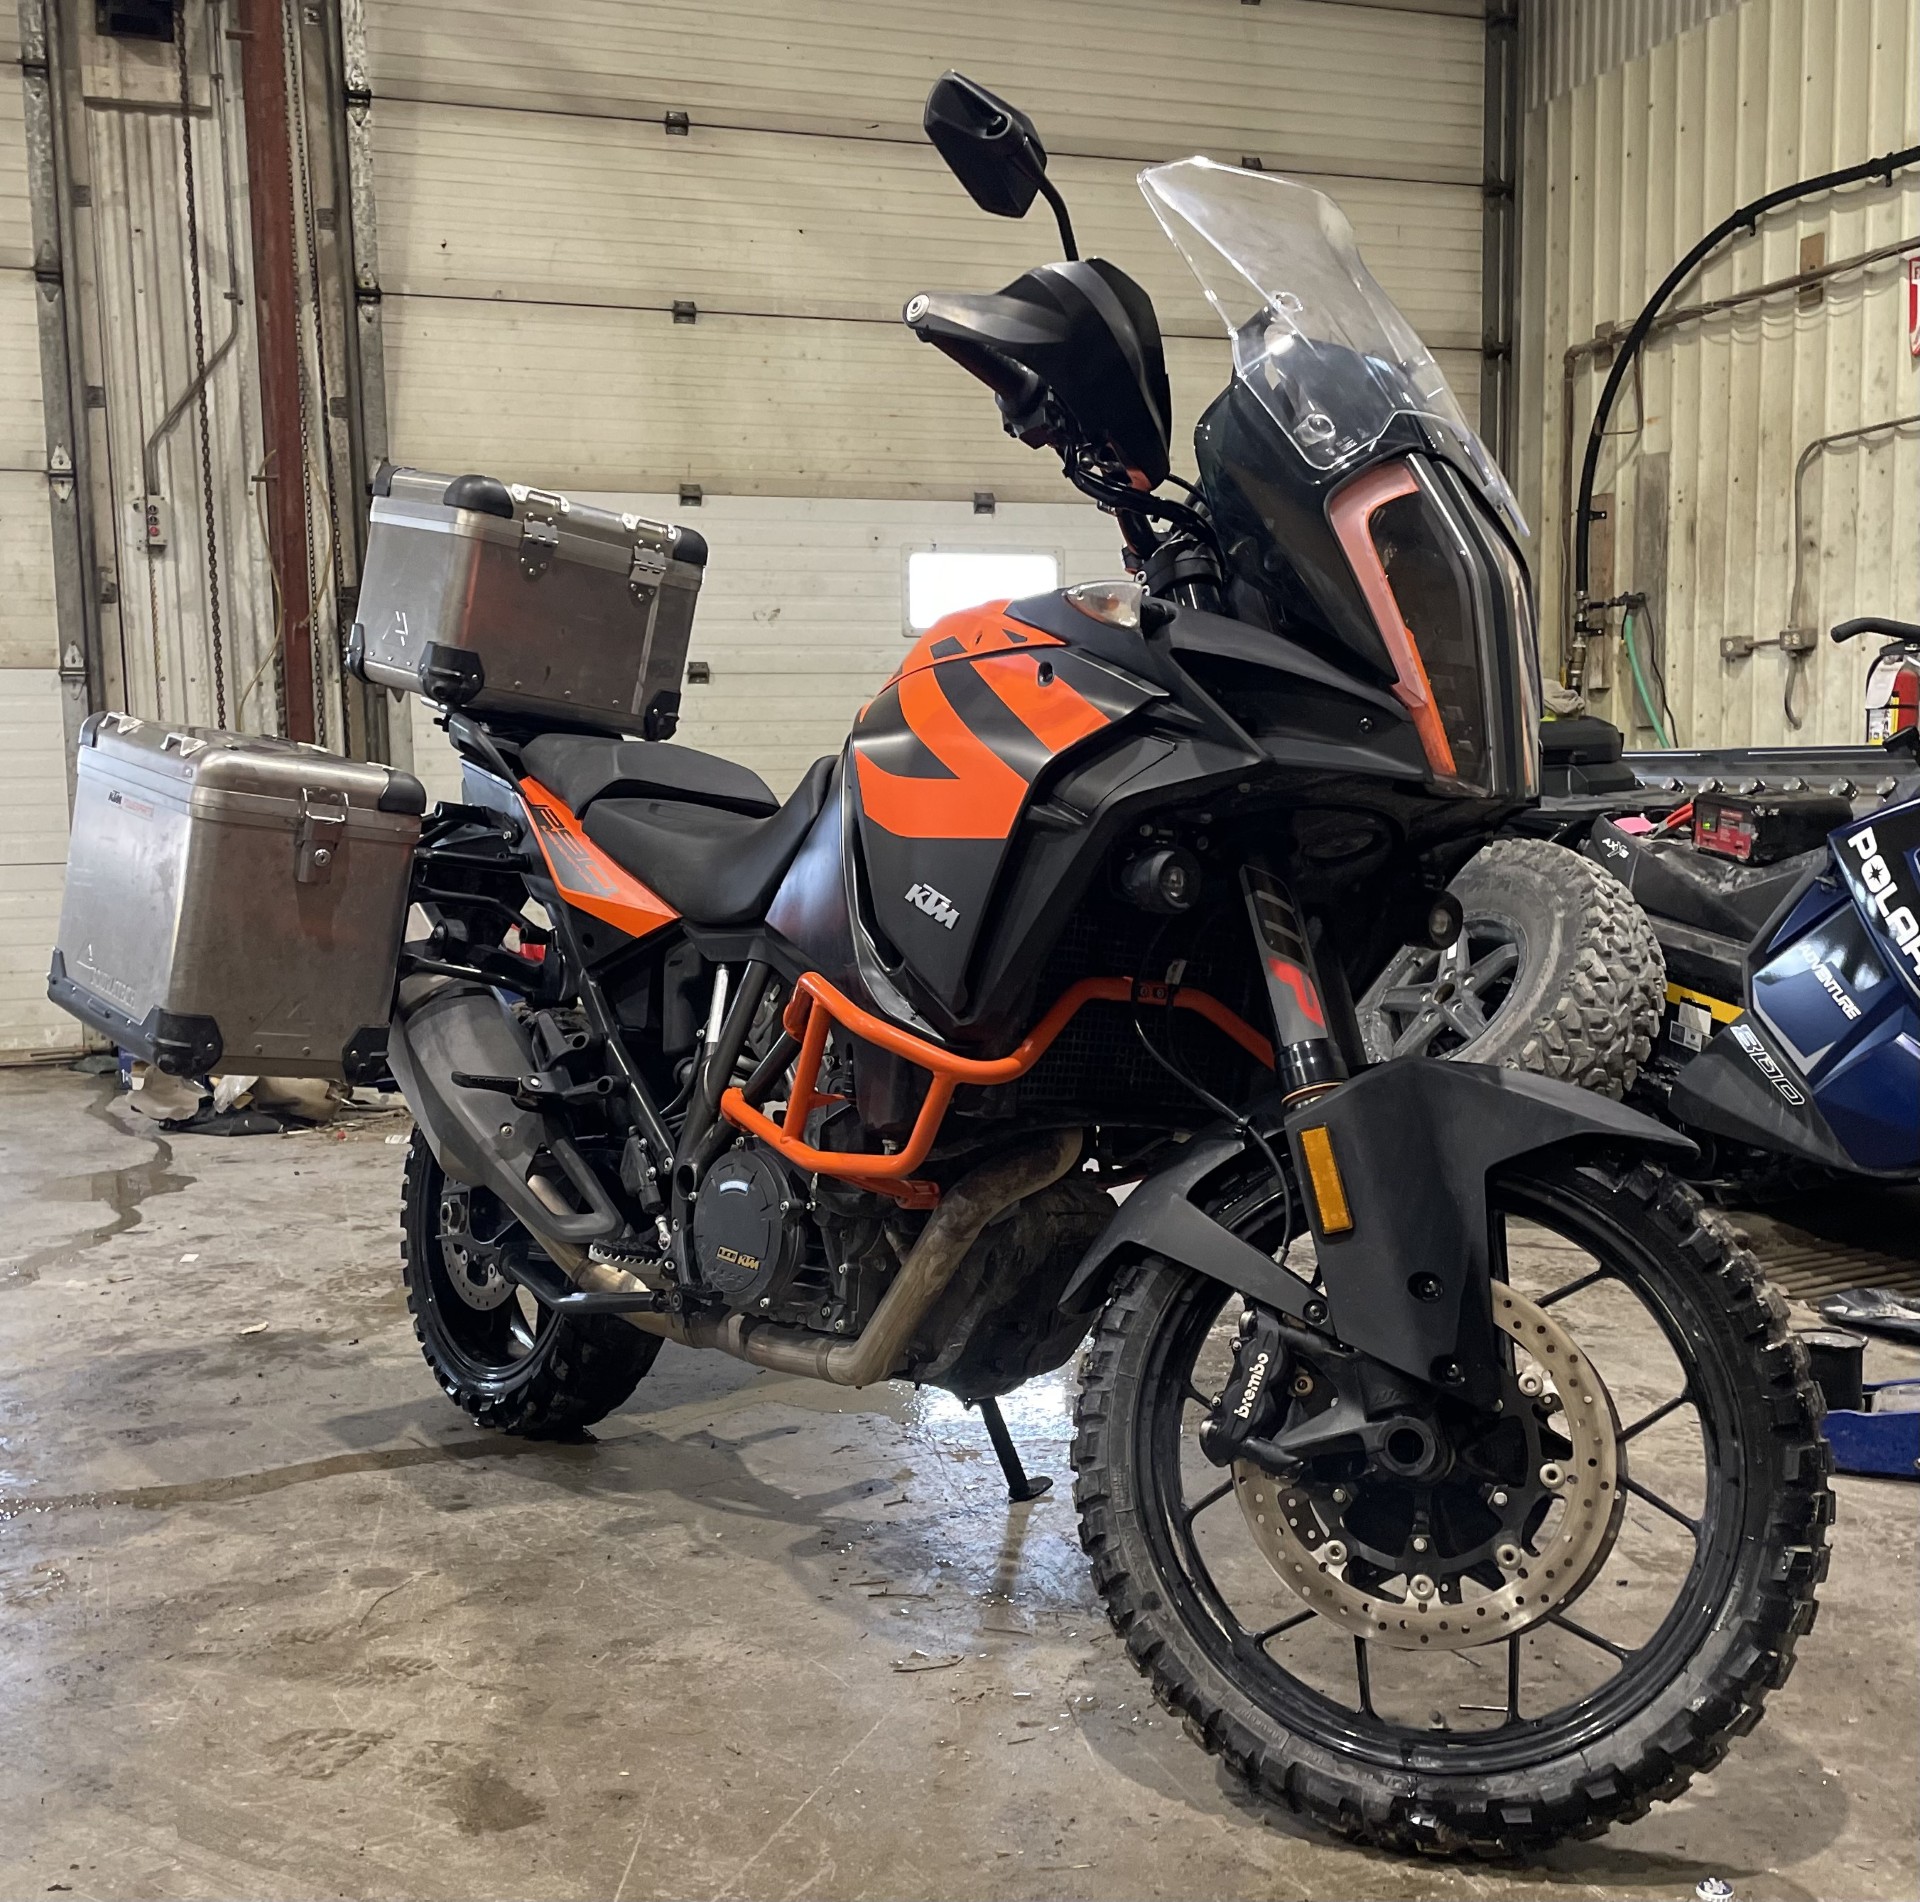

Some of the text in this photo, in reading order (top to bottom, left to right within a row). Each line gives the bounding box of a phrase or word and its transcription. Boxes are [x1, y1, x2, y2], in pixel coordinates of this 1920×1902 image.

[903, 883, 961, 931] KTM
[1799, 943, 1862, 1020] ADVENTURE
[1729, 1023, 1805, 1106] 800
[738, 1255, 760, 1270] KTM
[1233, 1352, 1269, 1419] brembo
